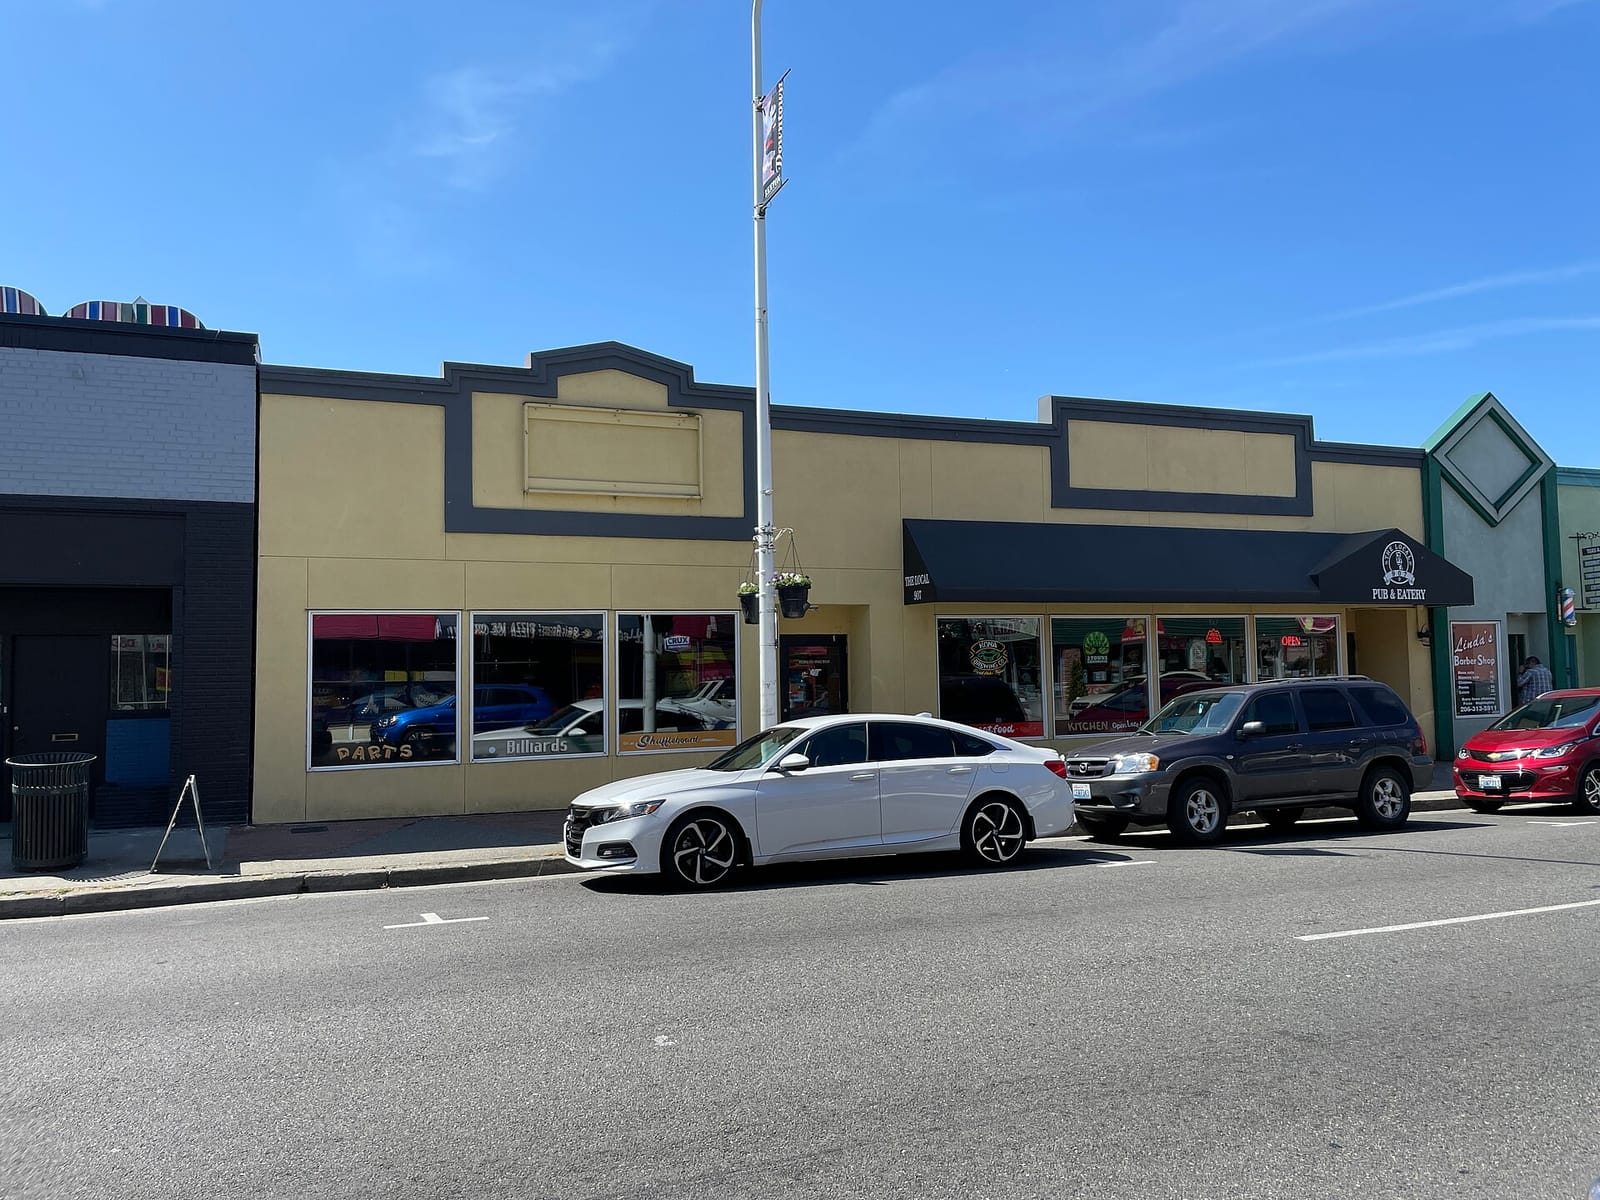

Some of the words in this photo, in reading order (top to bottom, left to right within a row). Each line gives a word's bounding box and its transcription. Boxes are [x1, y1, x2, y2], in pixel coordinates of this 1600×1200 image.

[1384, 546, 1394, 560] THE
[1394, 543, 1412, 561] LOCAL
[905, 575, 914, 586] THE
[914, 573, 930, 585] LOCAL
[1372, 588, 1388, 600] PUB
[1389, 588, 1396, 600] &
[1396, 588, 1426, 600] EATERY
[668, 636, 688, 644] CRUX
[1281, 635, 1301, 646] OPEN
[1454, 630, 1493, 653] Linda's
[1454, 655, 1476, 666] Barber
[1477, 654, 1496, 667] Shop
[992, 724, 1016, 733] food
[1067, 720, 1109, 731] KITCHEN
[506, 738, 568, 754] Billiards
[635, 734, 699, 749] Shuffleboard
